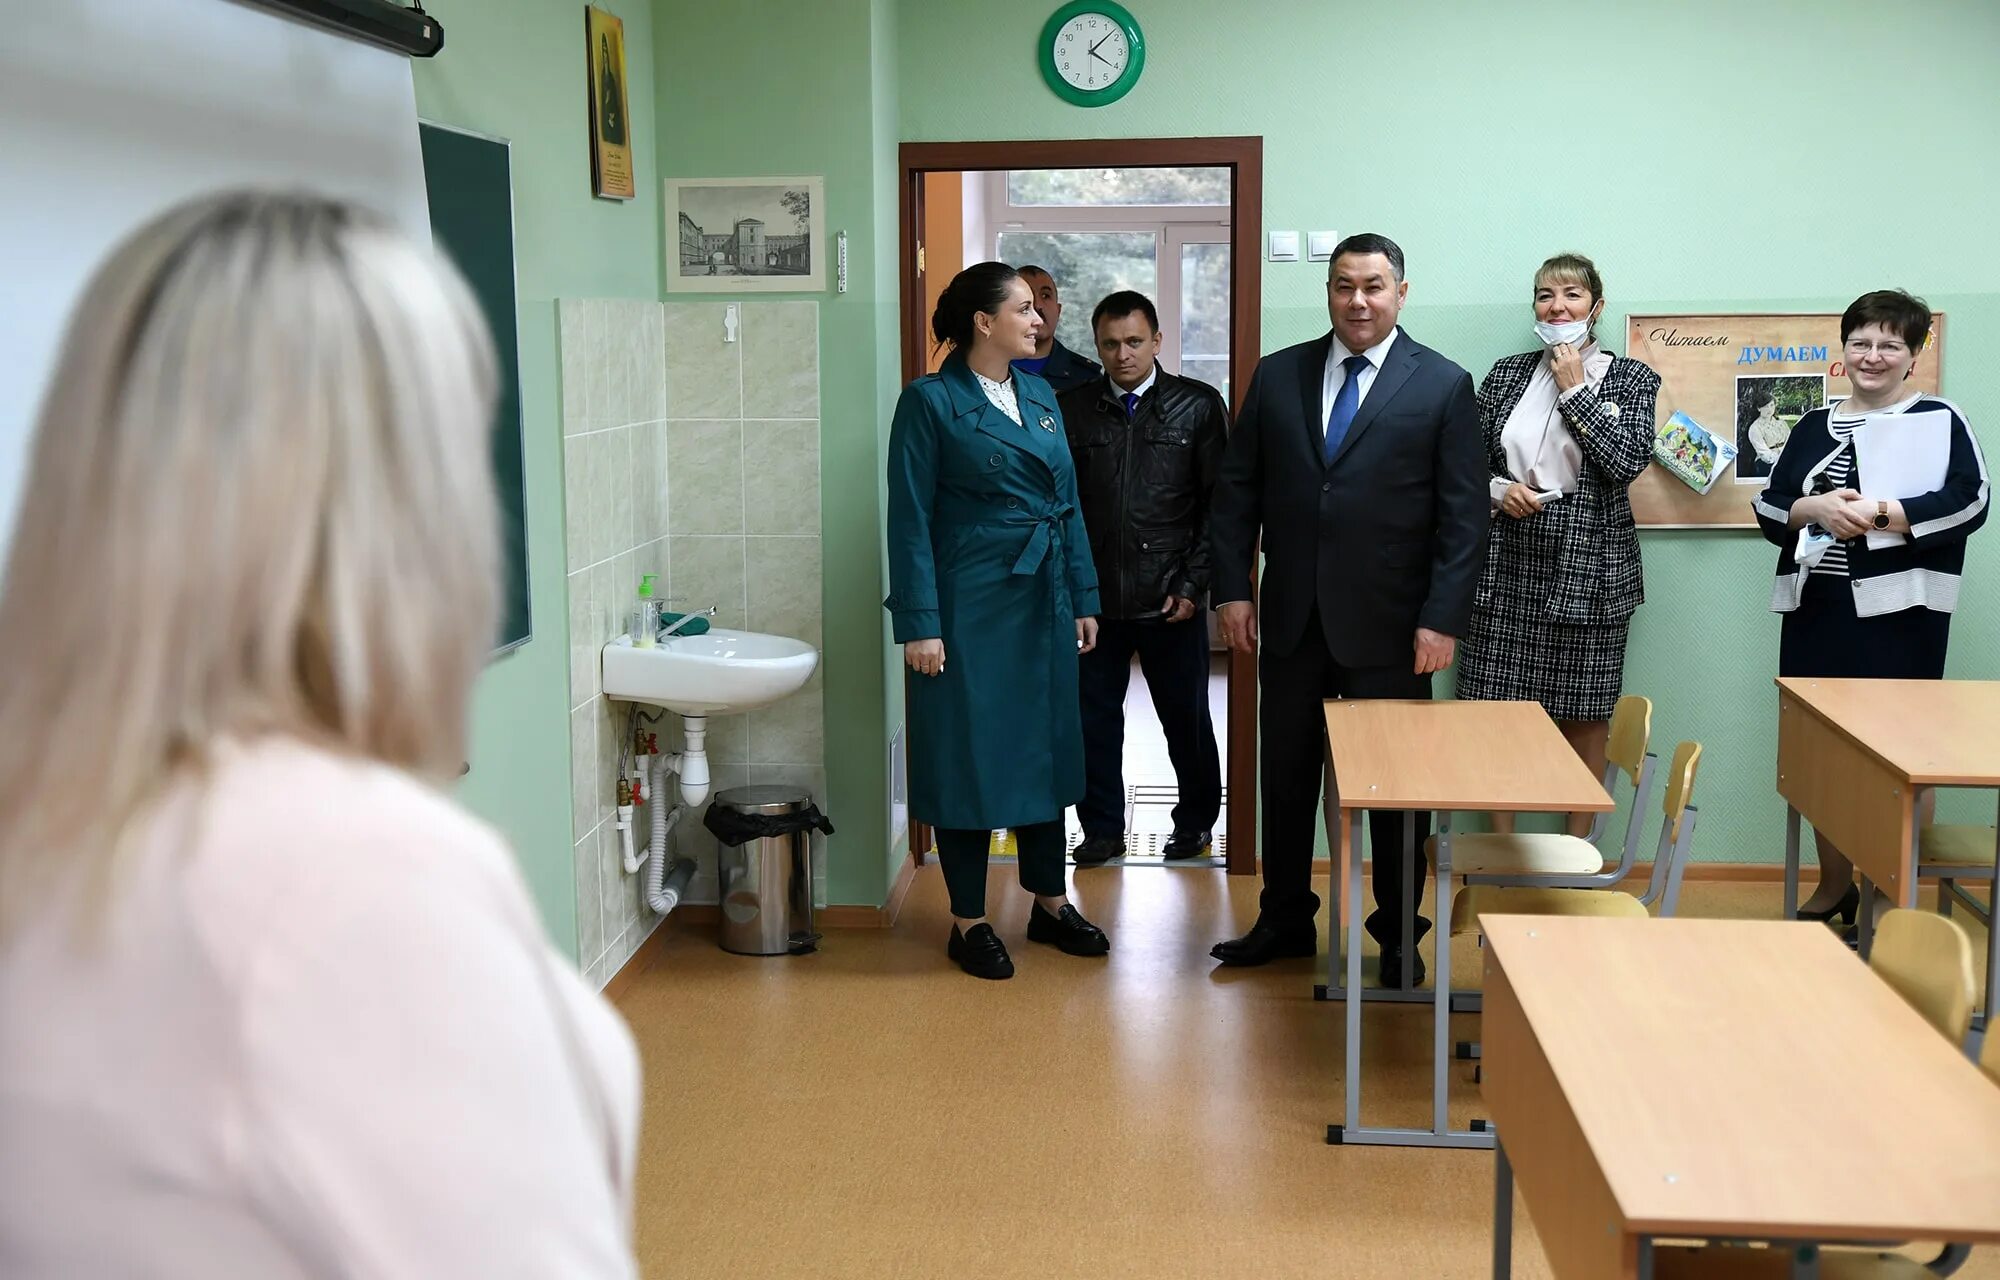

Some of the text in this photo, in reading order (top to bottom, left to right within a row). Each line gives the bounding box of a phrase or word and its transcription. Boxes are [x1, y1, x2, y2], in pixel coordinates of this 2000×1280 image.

[1088, 20, 1096, 28] 12
[1060, 48, 1065, 56] 9
[1118, 48, 1123, 56] 3
[1064, 62, 1069, 70] 8
[1114, 62, 1119, 70] 4
[1089, 76, 1094, 84] 6
[1649, 327, 1730, 347] Читаем
[1737, 345, 1828, 365] ДУМАЕМ
